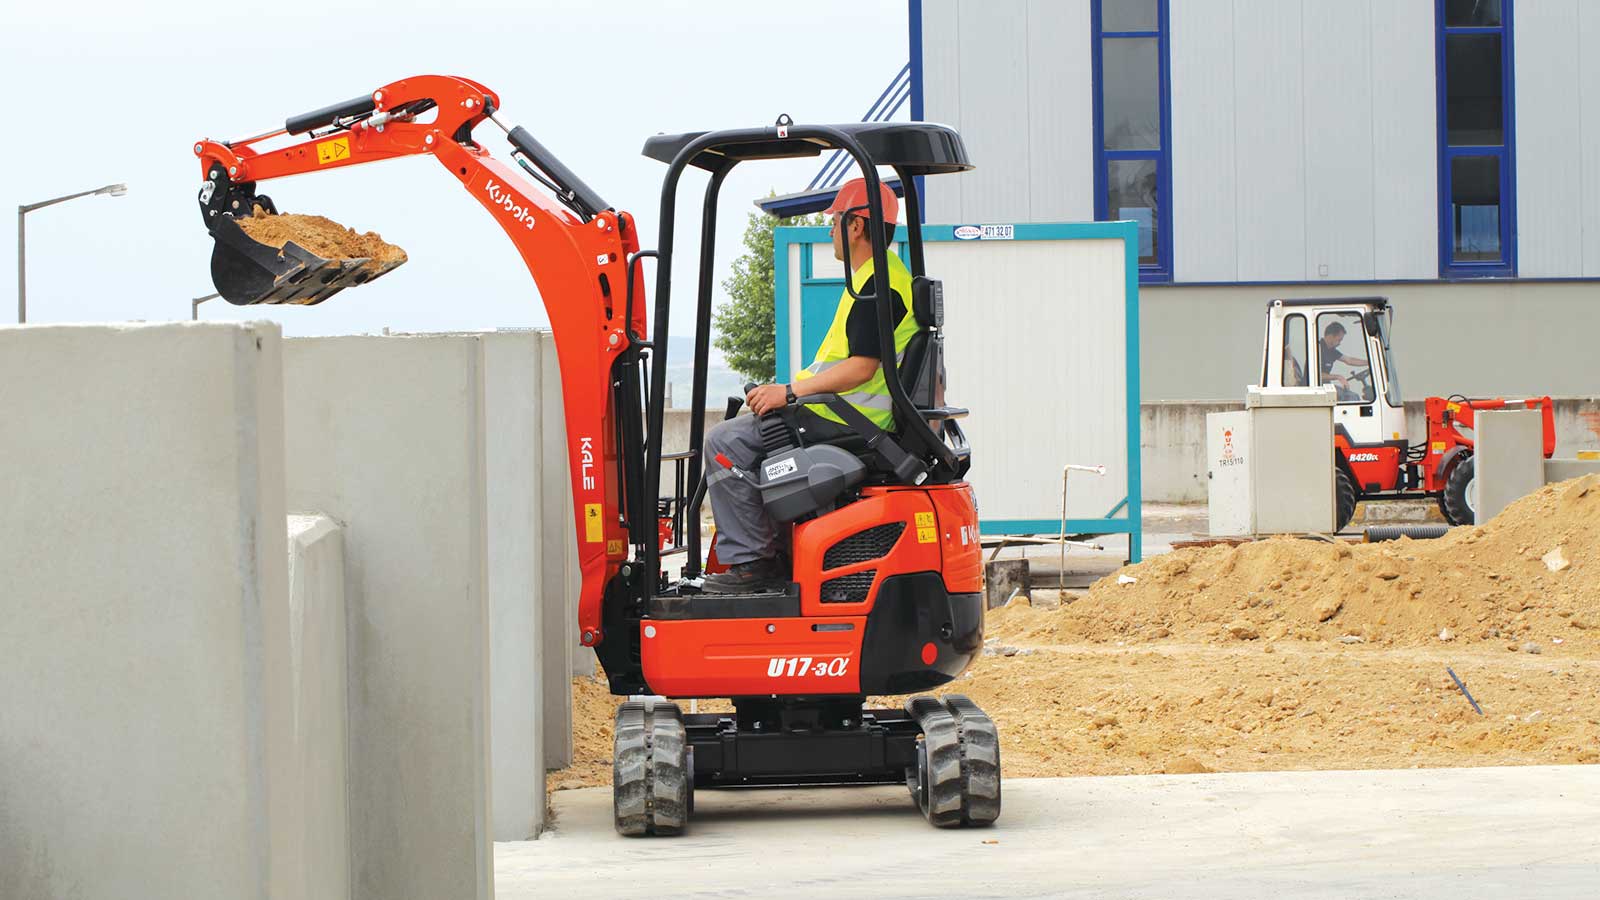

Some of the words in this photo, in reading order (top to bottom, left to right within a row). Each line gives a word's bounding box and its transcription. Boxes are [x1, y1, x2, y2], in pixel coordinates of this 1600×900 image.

[485, 179, 536, 231] Kubota
[985, 226, 995, 236] 471
[581, 437, 595, 490] KALE
